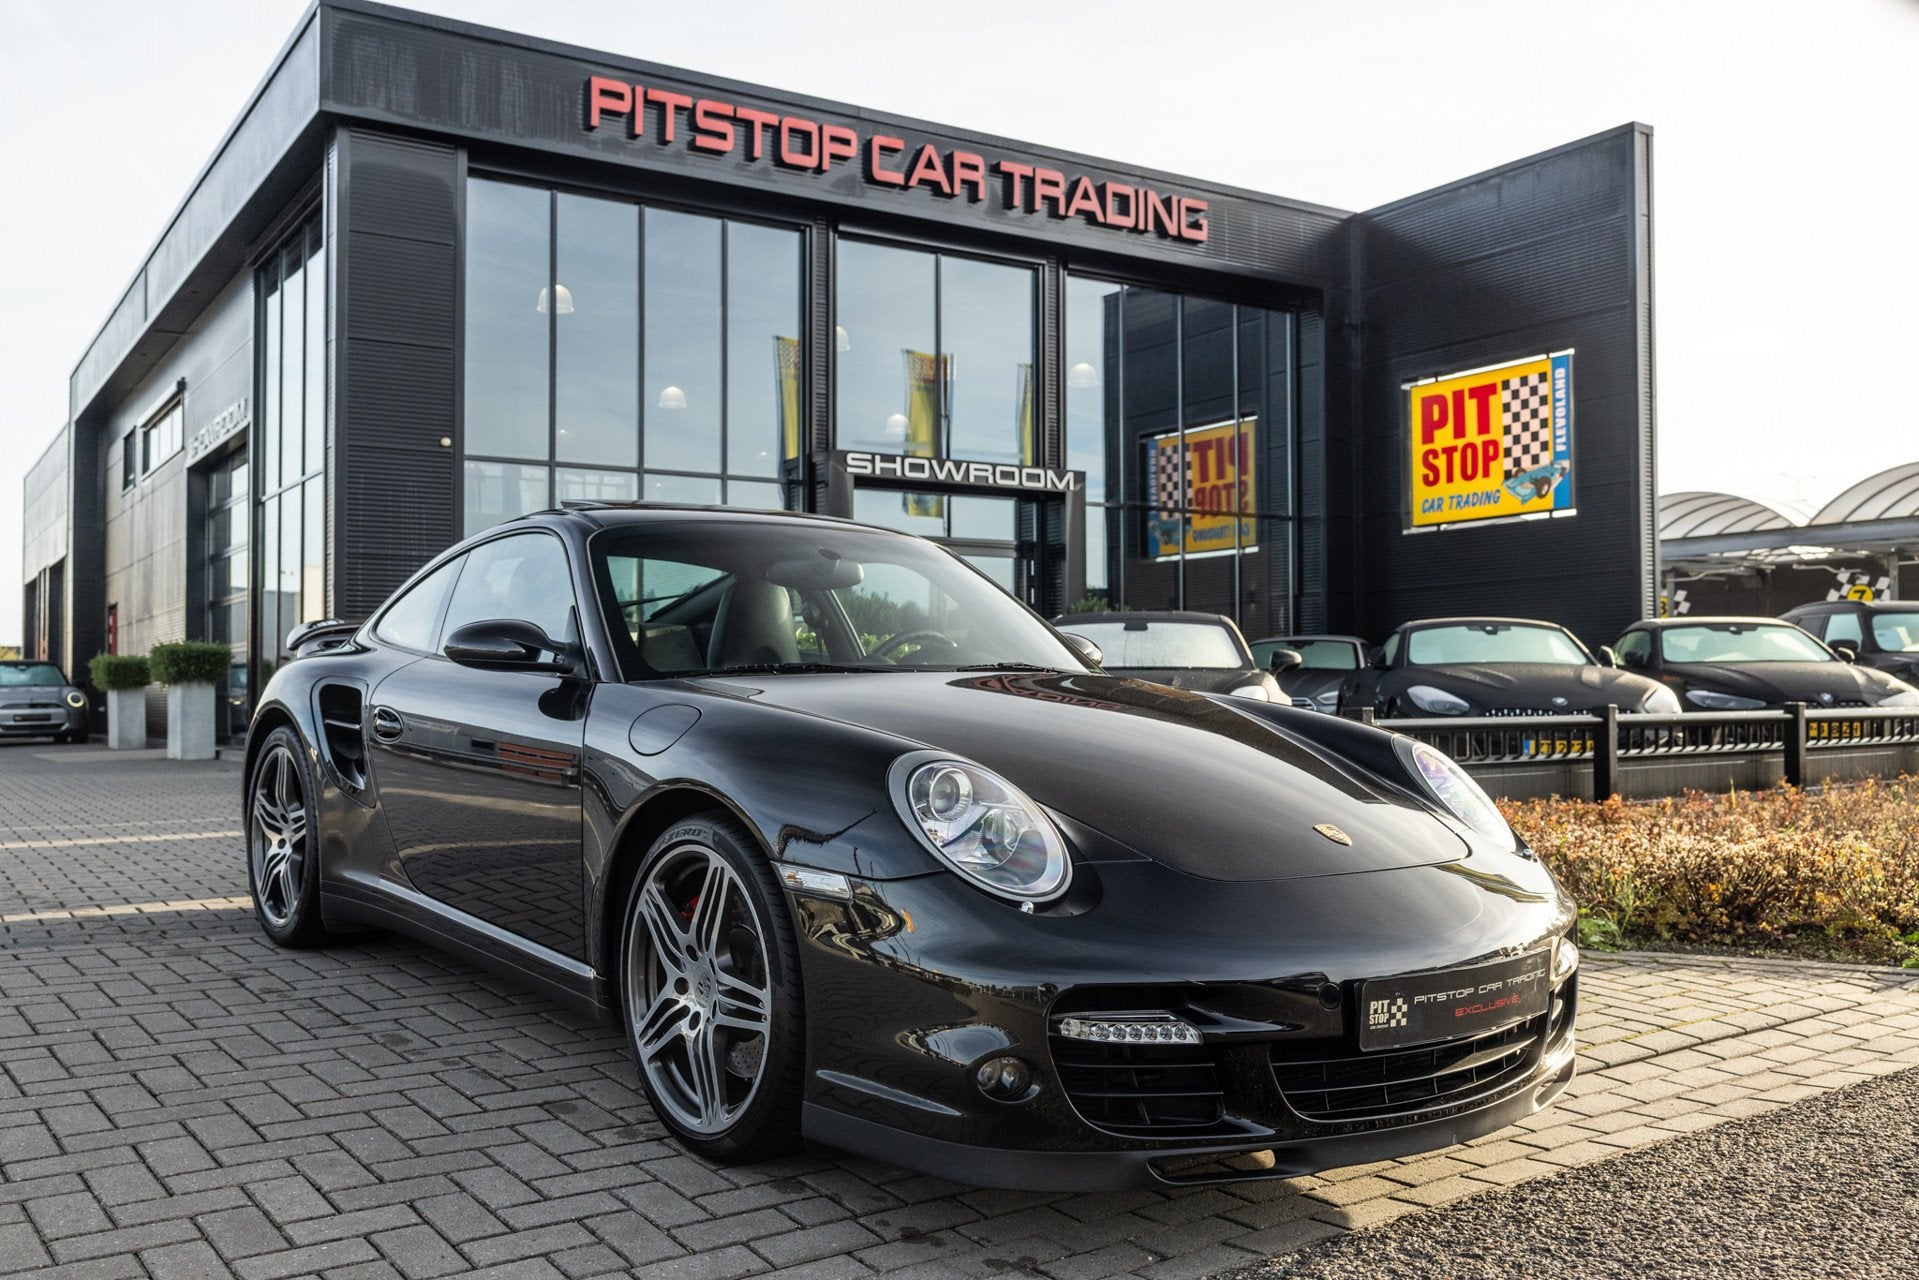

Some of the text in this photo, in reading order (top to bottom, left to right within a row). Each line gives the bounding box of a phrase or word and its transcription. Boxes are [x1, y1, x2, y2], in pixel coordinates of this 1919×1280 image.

[588, 75, 1209, 242] PITSTOP CAR TRADING
[1421, 382, 1498, 445] PIT
[1554, 367, 1567, 453] FLEVOLAND
[846, 452, 1075, 491] SHOWROOM
[1422, 439, 1500, 488] STOP
[1421, 489, 1502, 514] CAR TRADING
[1370, 1000, 1390, 1014] PIT
[1414, 987, 1475, 1005] PITSTOP
[1478, 981, 1503, 994] CAR
[1455, 993, 1520, 1017] EXCLUSIVE
[1369, 1012, 1390, 1025] STOP
